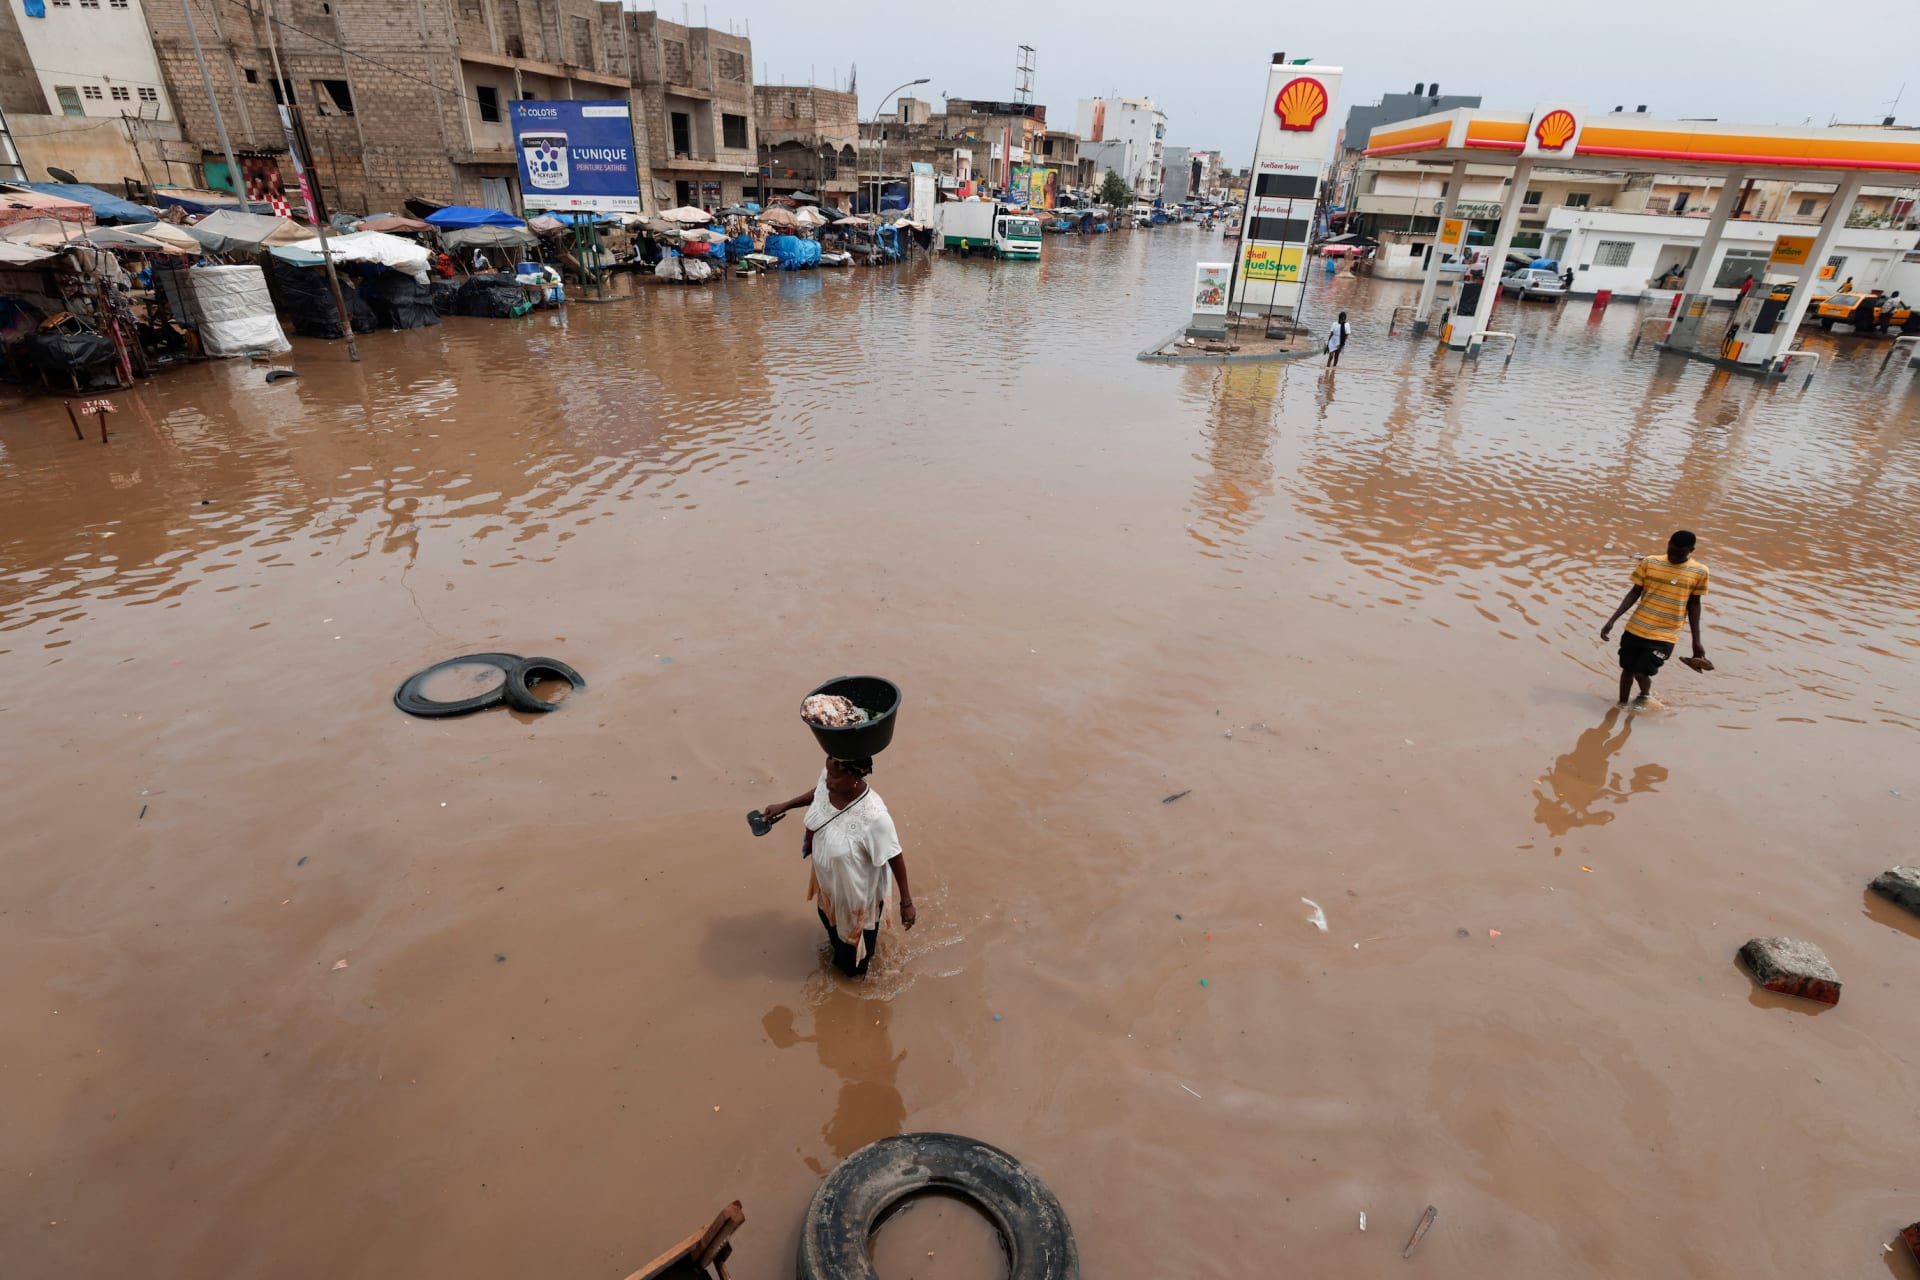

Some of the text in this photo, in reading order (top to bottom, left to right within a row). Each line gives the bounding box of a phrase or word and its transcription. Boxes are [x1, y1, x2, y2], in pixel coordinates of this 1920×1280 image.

[572, 148, 627, 161] L'UNIQUE
[1261, 161, 1283, 169] FuelSave
[1246, 250, 1267, 259] Shell
[1244, 259, 1297, 272] FuelSave
